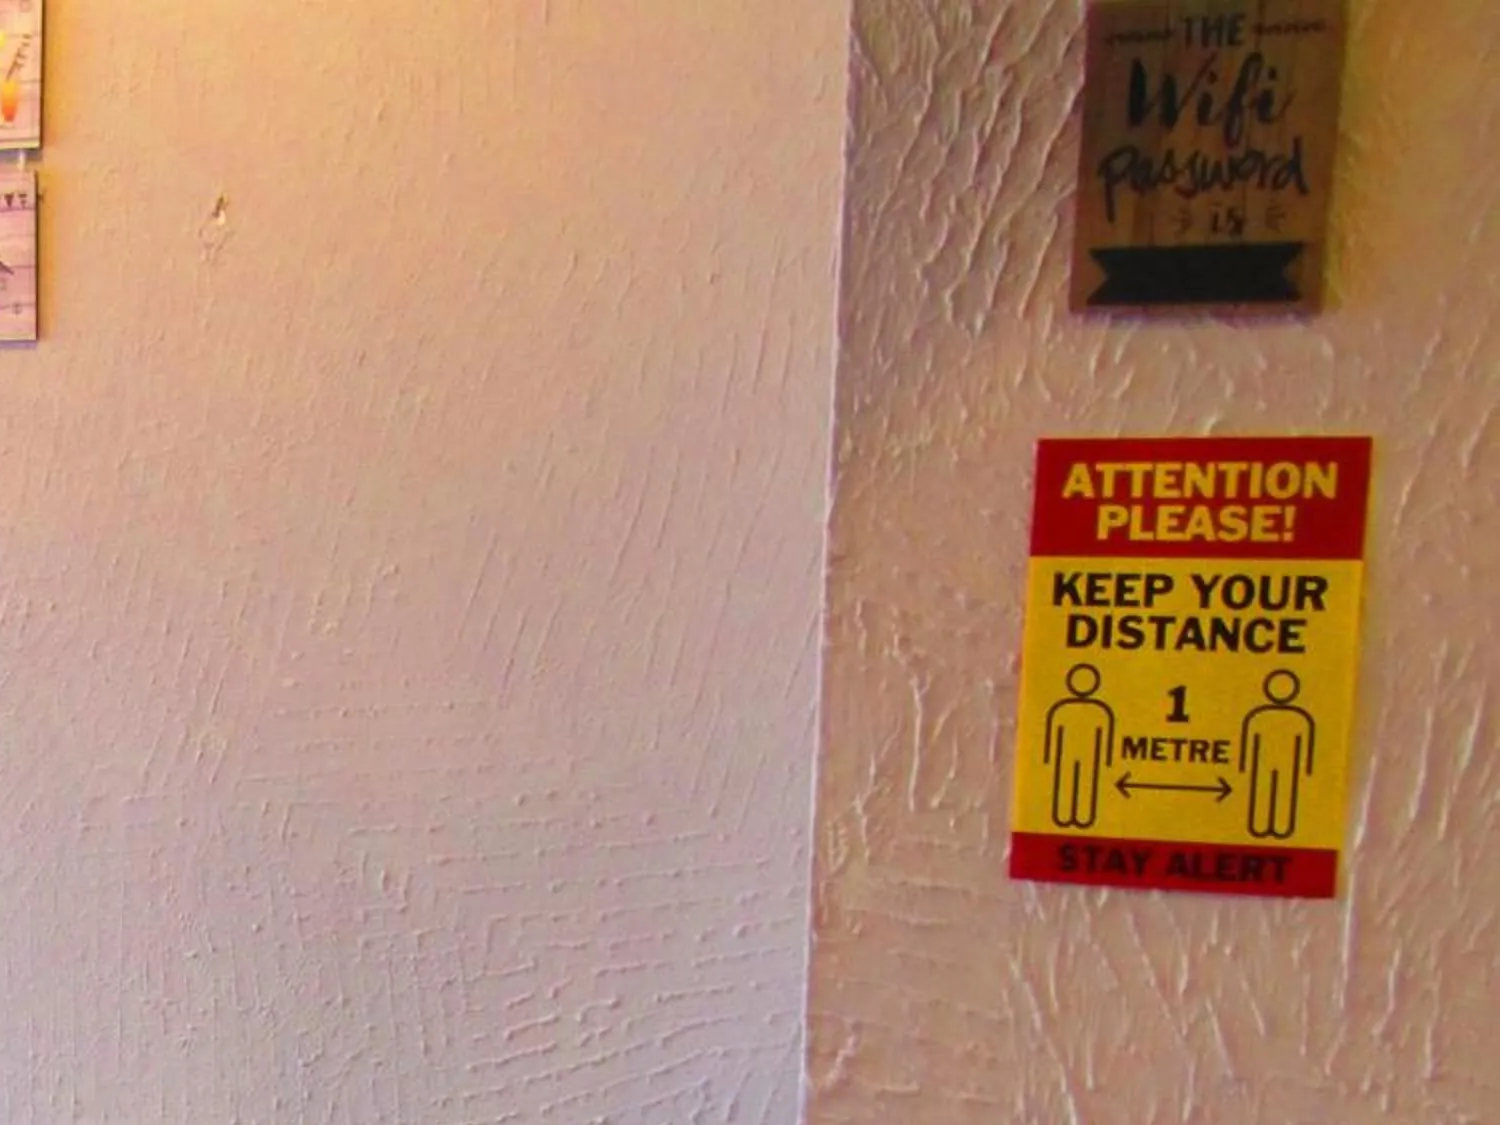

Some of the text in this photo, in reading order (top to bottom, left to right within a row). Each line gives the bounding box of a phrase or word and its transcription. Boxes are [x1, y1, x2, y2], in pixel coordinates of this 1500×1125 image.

[1183, 14, 1246, 47] THE
[1128, 52, 1295, 147] Wifi
[1062, 462, 1338, 498] ATTENTION
[1097, 505, 1296, 541] PLEASE!
[1053, 572, 1328, 611] KEEP YOUR
[1066, 614, 1307, 653] DISTANCE
[1166, 685, 1190, 723] 1
[1121, 736, 1231, 764] METRE
[1058, 843, 1292, 884] STAY ALERT
